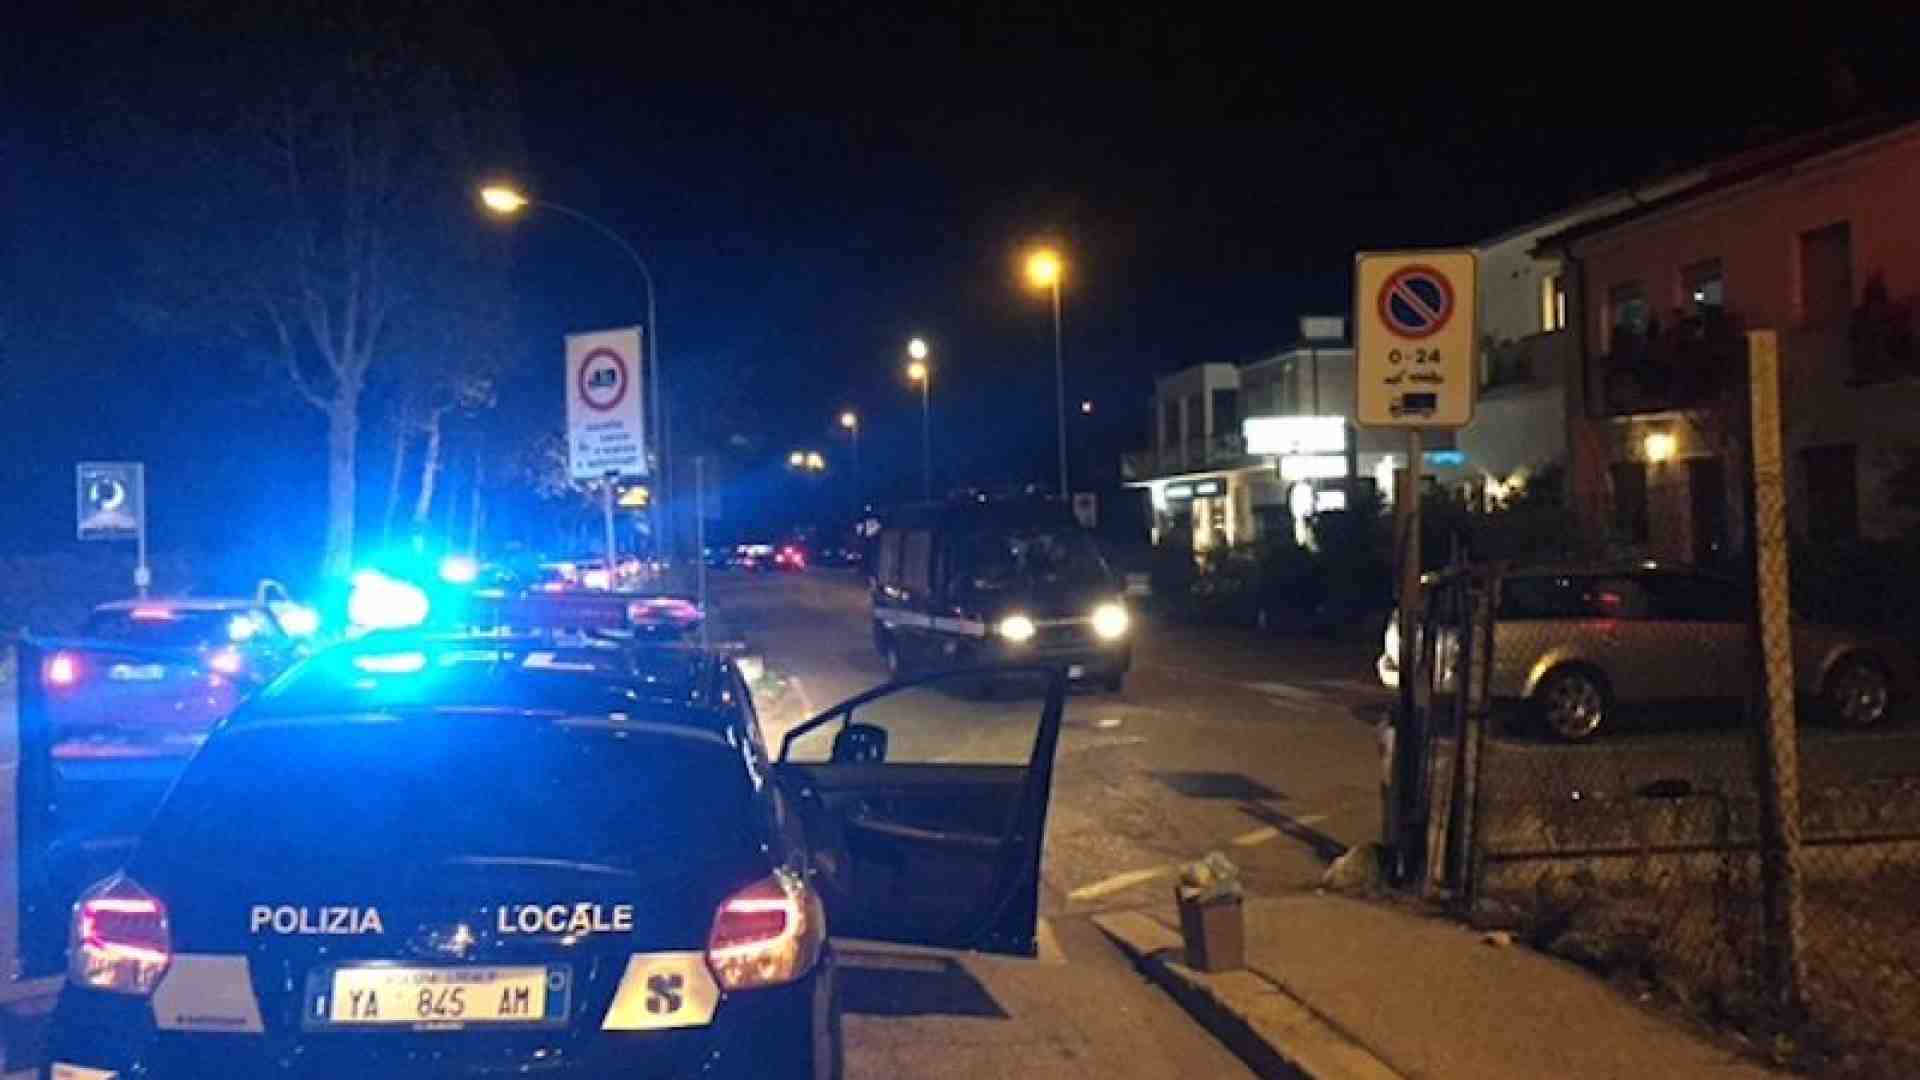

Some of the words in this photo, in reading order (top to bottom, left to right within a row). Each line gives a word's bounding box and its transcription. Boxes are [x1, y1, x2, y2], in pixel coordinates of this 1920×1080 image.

[250, 905, 384, 934] POLIZIA
[498, 904, 633, 934] LOCALE
[349, 989, 379, 1018] YA
[416, 987, 465, 1017] 845
[497, 985, 531, 1015] AM
